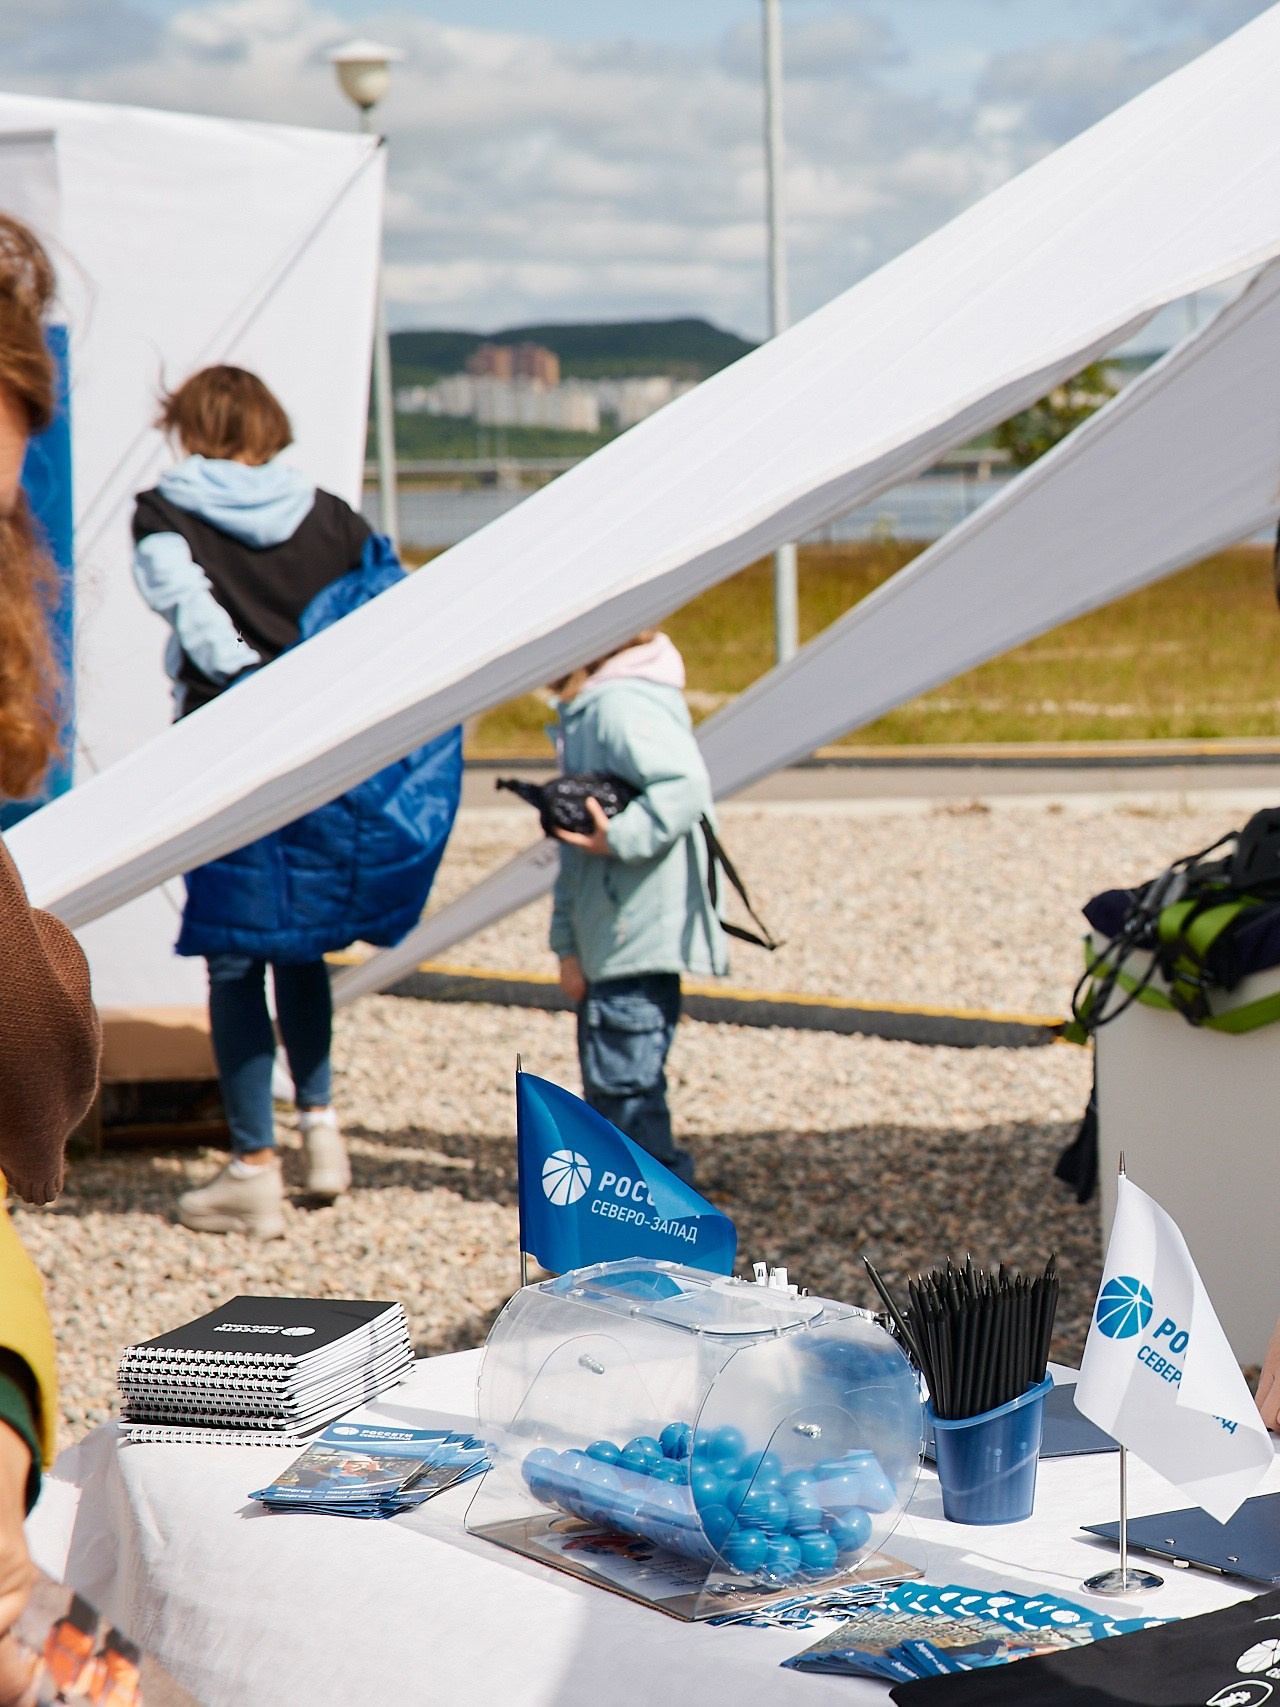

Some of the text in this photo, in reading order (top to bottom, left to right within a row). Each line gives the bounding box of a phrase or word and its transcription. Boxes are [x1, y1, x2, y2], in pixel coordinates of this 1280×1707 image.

[591, 1199, 698, 1245] СЕВЕРО-ЗАПАД
[1152, 1317, 1190, 1360] РО
[1137, 1345, 1183, 1391] СЕВЕР
